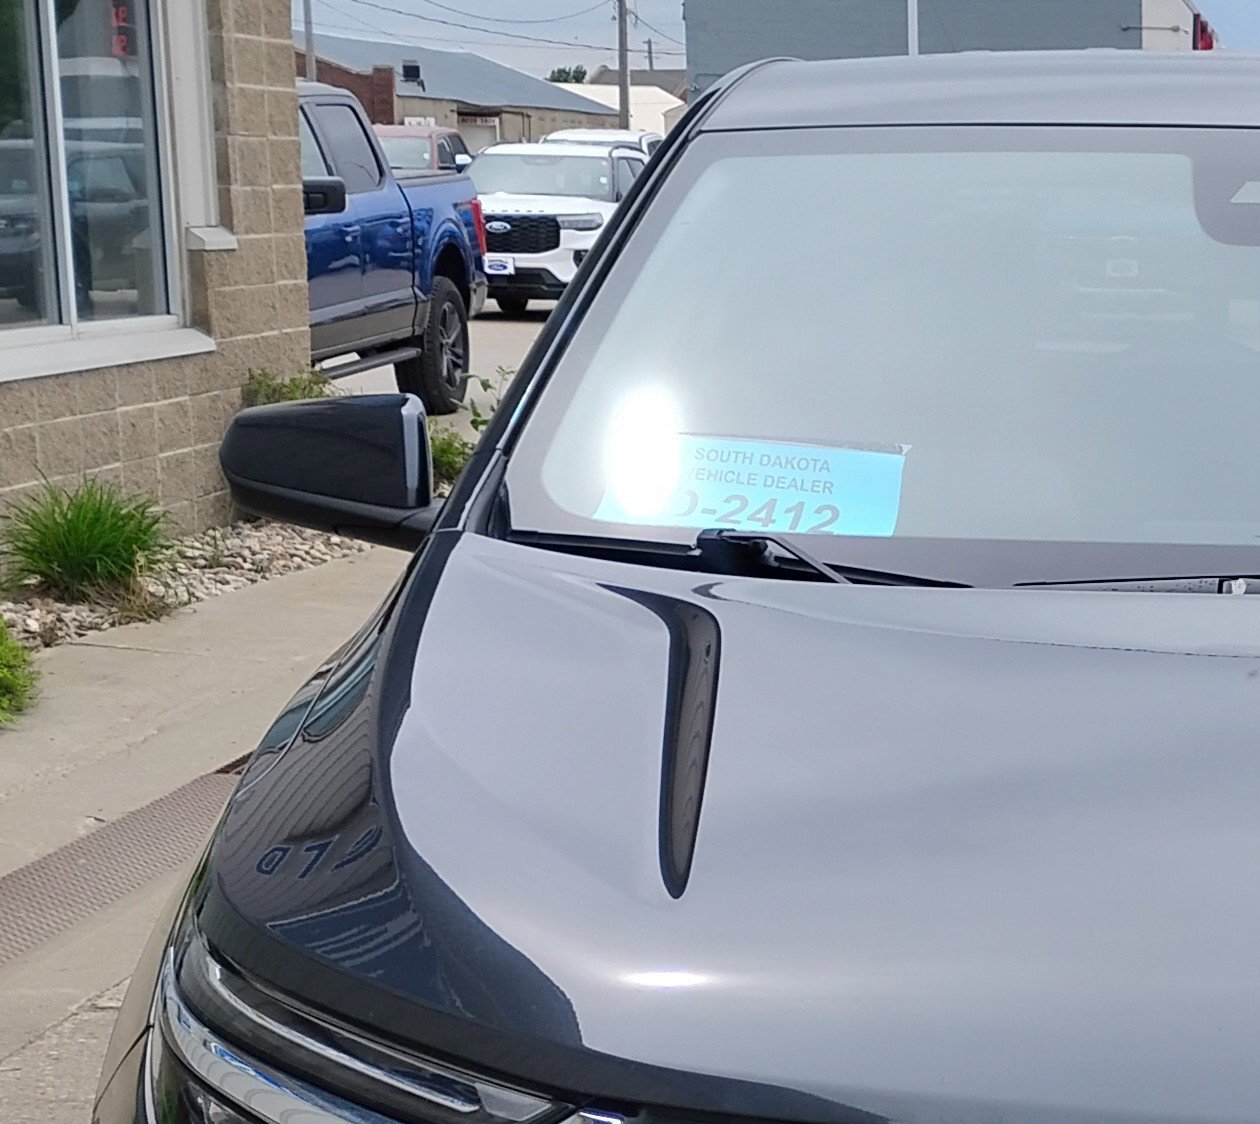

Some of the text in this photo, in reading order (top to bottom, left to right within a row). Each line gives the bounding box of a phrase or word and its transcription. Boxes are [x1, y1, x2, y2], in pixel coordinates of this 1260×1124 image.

[695, 448, 831, 473] SOUTH DAKOTA
[763, 475, 834, 494] DEALER
